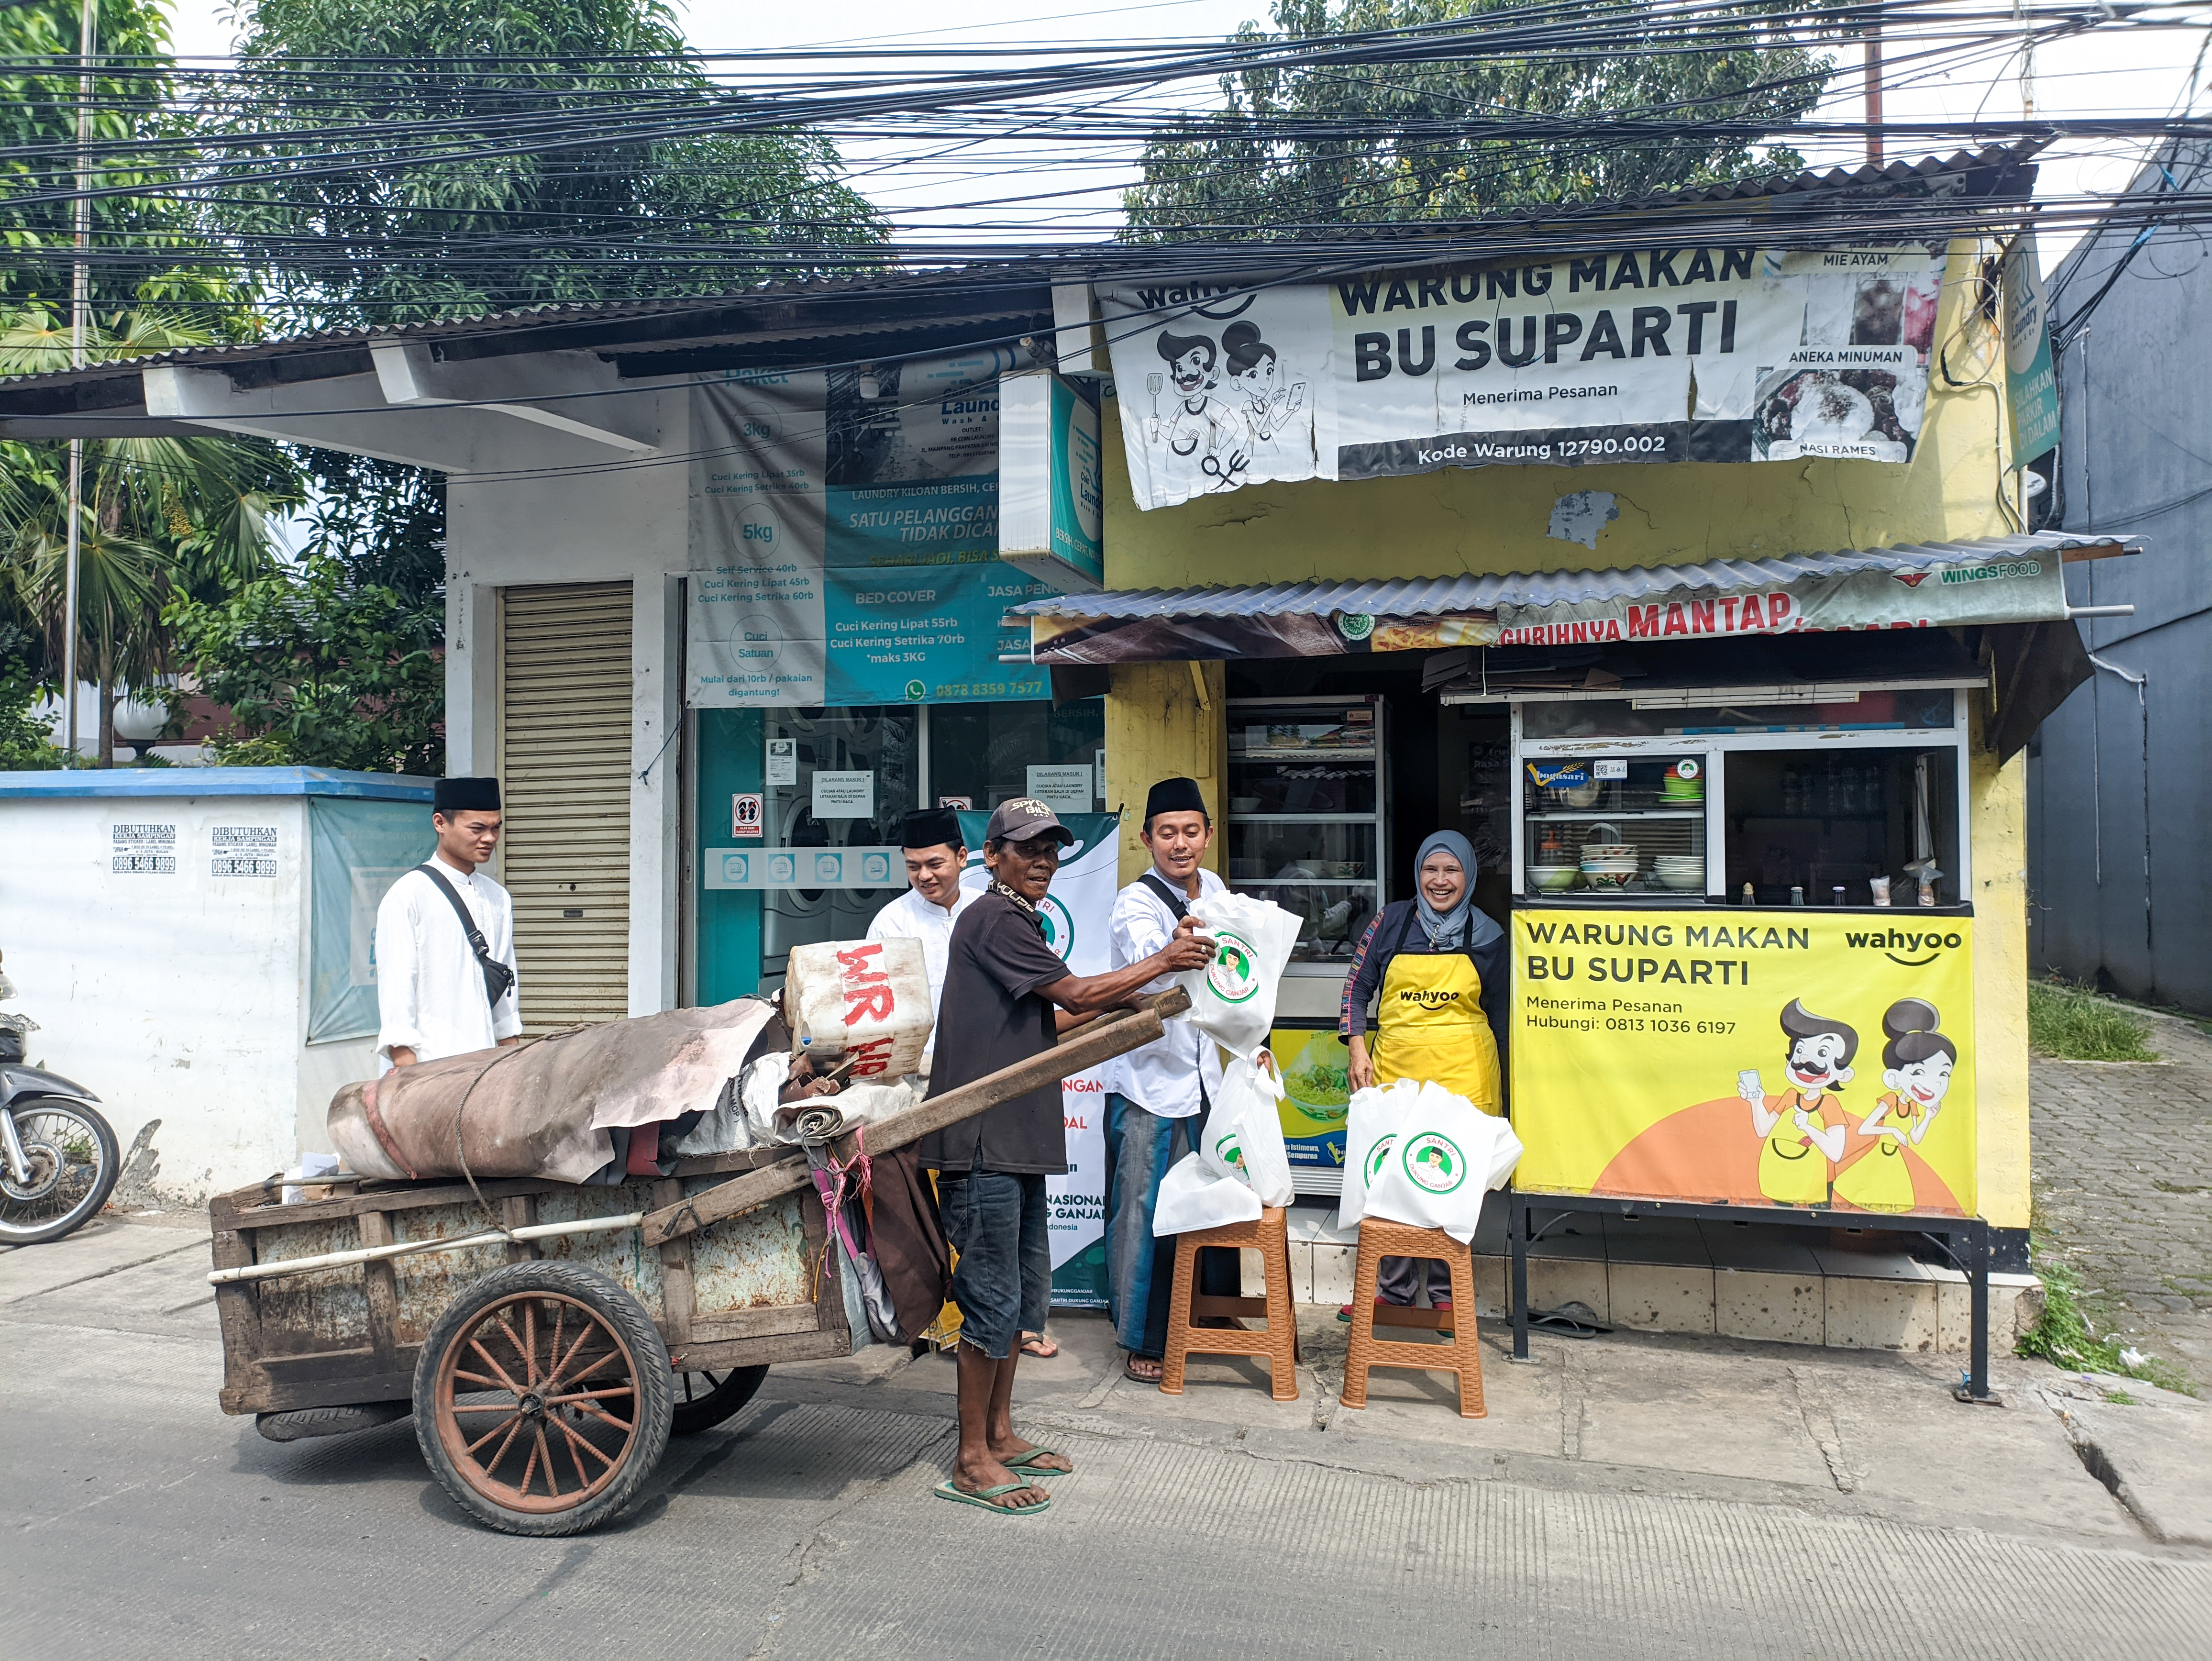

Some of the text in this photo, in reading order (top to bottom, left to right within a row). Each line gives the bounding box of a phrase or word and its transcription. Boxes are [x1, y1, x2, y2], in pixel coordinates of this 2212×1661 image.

[1824, 254, 1888, 266] MIE AYAM
[1338, 248, 1756, 316] WARUNG MAKAN
[2012, 305, 2037, 341] Laundry
[1355, 300, 1738, 382] BU SUPARTI
[1790, 351, 1902, 363] ANEKA MINUMAN
[1463, 384, 1618, 406] Menerima Pesanan
[744, 422, 770, 439] 3kg
[1418, 436, 1665, 465] Kode Warung 12790.002
[1800, 444, 1876, 455] NASI RAMES
[733, 471, 759, 480] Kering
[786, 469, 805, 477] 35rb
[727, 484, 753, 493] Kering
[755, 483, 786, 491] Setrika
[852, 483, 980, 500] LAUNDRY KILOAN BERSIH,
[850, 505, 999, 528] SATU PELANGGAN
[743, 523, 773, 543] 5kg
[900, 526, 951, 543] TIDAK
[1056, 527, 1073, 549] BERSIH,
[958, 551, 988, 563] BISA
[716, 564, 797, 574] Self Service 40rb
[1941, 562, 2040, 583] WINGSFOOD
[704, 577, 810, 589] Cuci Kering Lipat 45rb
[698, 591, 814, 603] Cuci Kering Setrika 60rb
[855, 590, 936, 604] BED COVER
[988, 585, 1023, 597] JASA
[835, 618, 958, 632] Cuci Kering Lipat 55rb
[744, 632, 768, 642] Cuci
[1500, 620, 1622, 645] GURIHNYA
[830, 634, 965, 649] Cuci Kering Setrika 70rb
[997, 639, 1031, 651] JASA
[738, 648, 774, 658] Satuan
[903, 652, 926, 663] 3KG
[700, 675, 724, 684] Mulai
[727, 675, 745, 684] dari
[747, 675, 767, 683] 10rb
[775, 674, 812, 685] pakaian
[729, 688, 780, 698] digantung!
[936, 681, 1042, 697] 0878 8359 7577
[1536, 771, 1584, 781] bogasari
[113, 824, 176, 833] DIBUTUHKAN
[212, 827, 277, 836] DIBUTUHKAN
[113, 857, 175, 871] 0896 5466 9899
[213, 860, 276, 874] 0896 5466 9899
[1526, 922, 1809, 950] WARUNG MAKAN
[1845, 928, 1962, 952] wahyoo
[1222, 937, 1254, 958] SANTRI
[1527, 956, 1749, 986] BU SUPARTI
[1210, 963, 1250, 997] DUKUNG GANJAR
[1400, 990, 1460, 1003] wahyoo
[1526, 996, 1683, 1014] Menerima Pesanan
[1526, 1014, 1736, 1034] Hubungi: 0813 1036 6197
[1426, 1137, 1456, 1156] SANTRI
[1409, 1163, 1453, 1189] DUKUNG GANJAR
